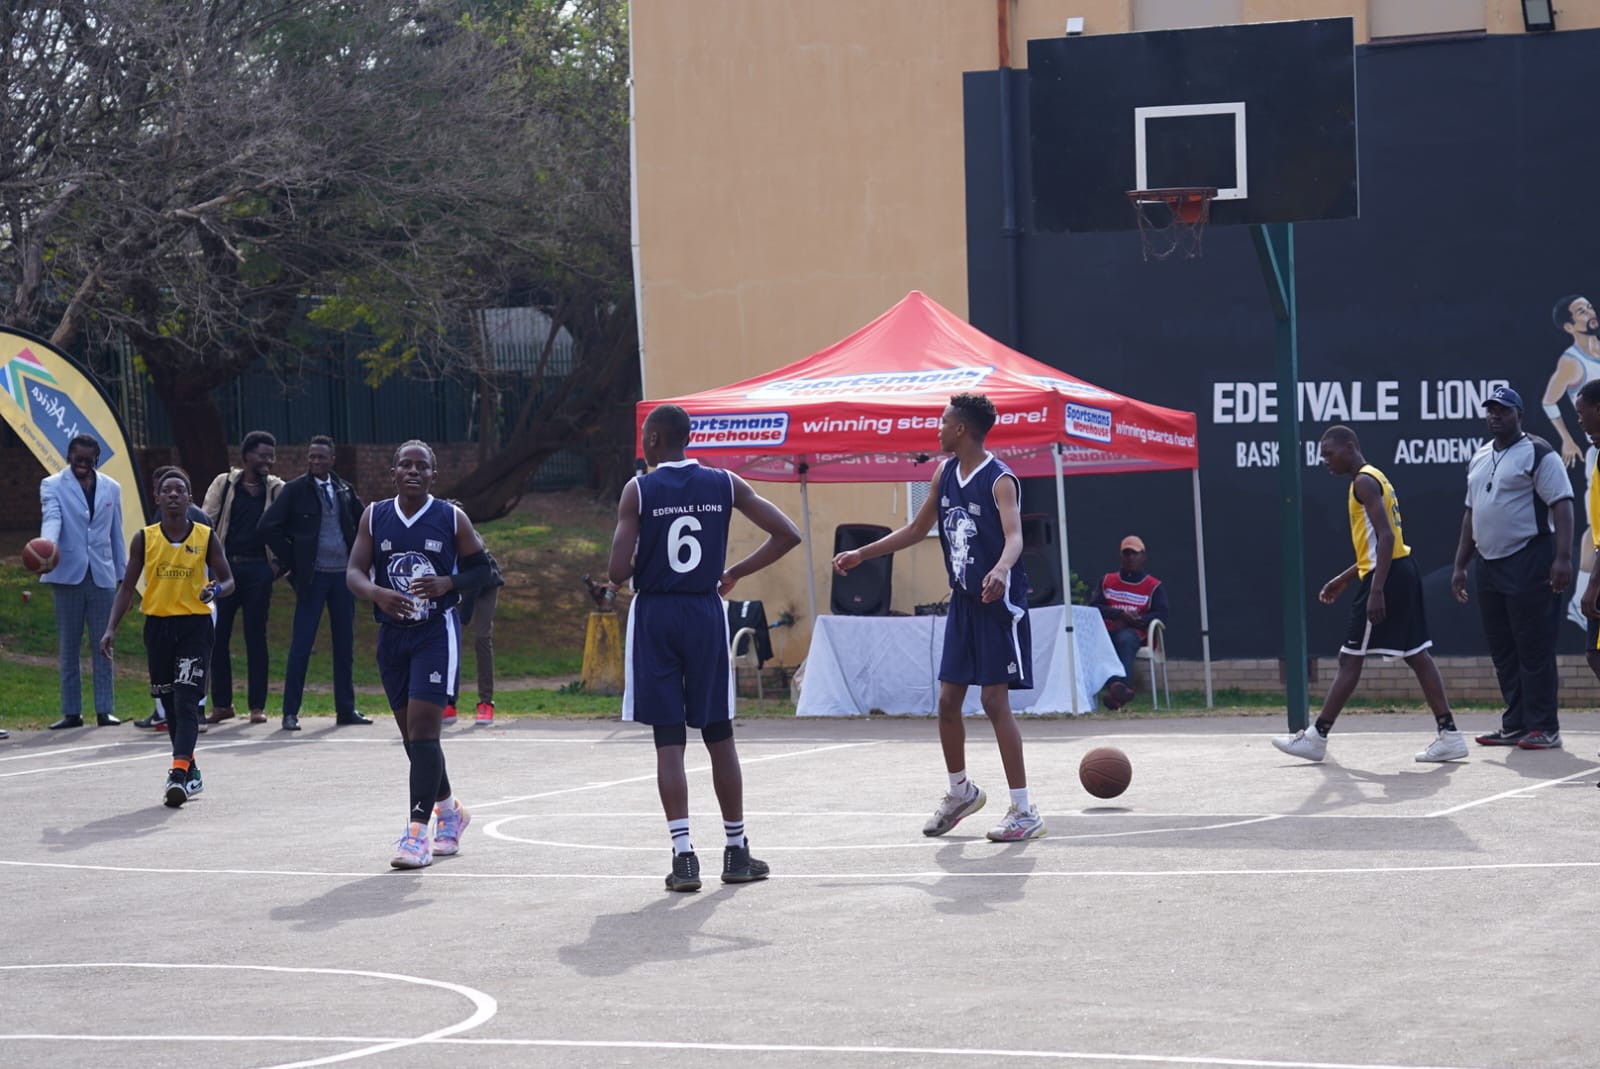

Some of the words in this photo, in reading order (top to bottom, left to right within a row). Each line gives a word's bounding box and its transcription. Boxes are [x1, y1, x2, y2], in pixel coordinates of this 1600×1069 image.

[766, 370, 980, 391] Sportsmans
[689, 417, 785, 431] ortsmans
[802, 415, 893, 434] winning
[1066, 406, 1110, 426] Sportsmans
[1115, 420, 1148, 443] winning
[1148, 428, 1174, 445] starts
[1174, 431, 1196, 448] here!
[652, 504, 694, 517] EDENVALE
[696, 504, 723, 513] LIONS
[667, 515, 702, 573] 6
